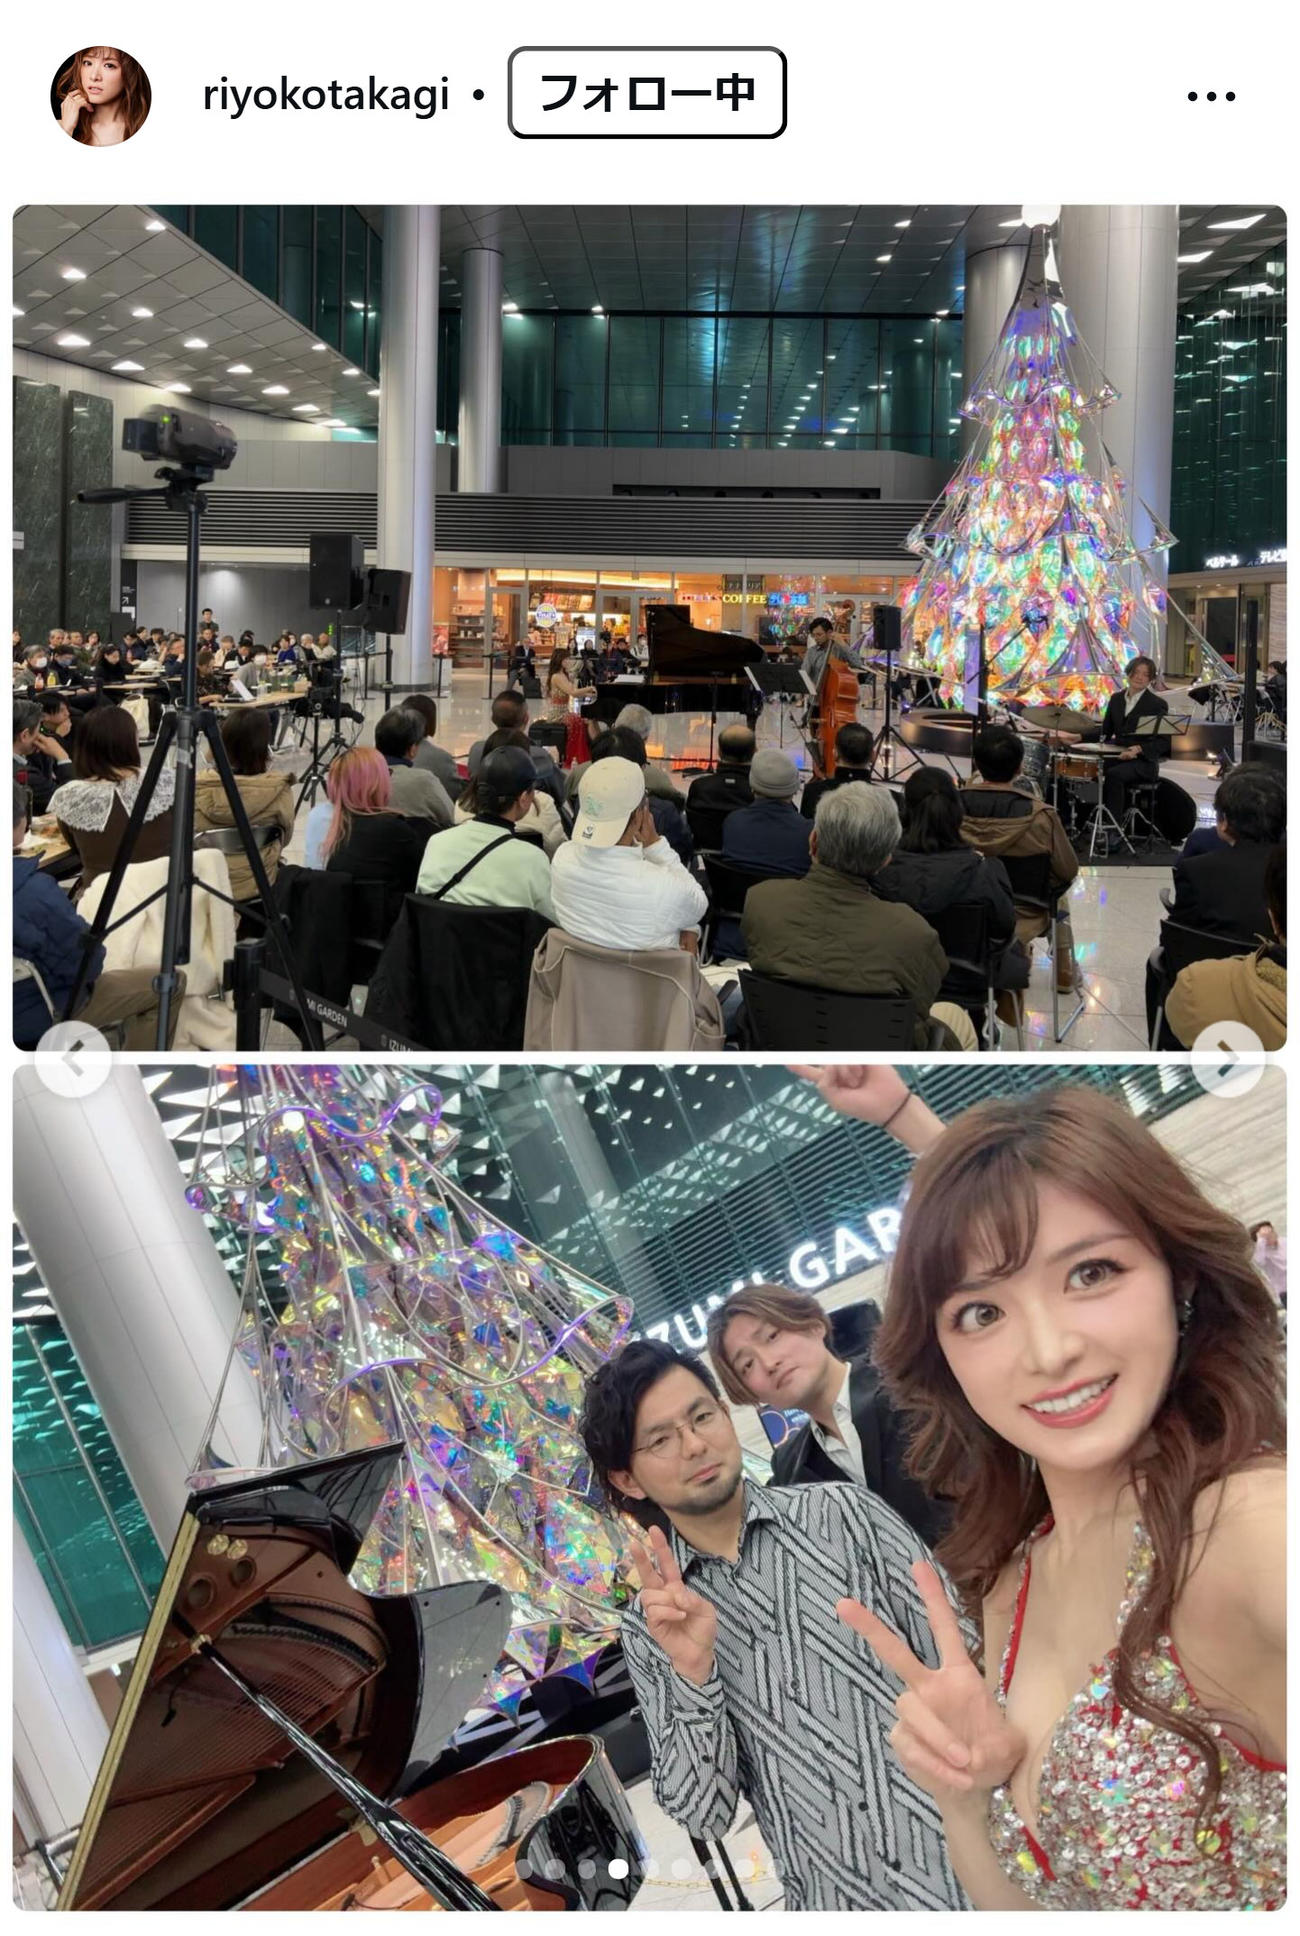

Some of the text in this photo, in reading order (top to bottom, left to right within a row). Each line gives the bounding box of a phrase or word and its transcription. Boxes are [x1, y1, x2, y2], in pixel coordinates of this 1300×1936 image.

[317, 1003, 348, 1027] GARDEN
[389, 1039, 413, 1051] IZU
[788, 1200, 906, 1288] GAR
